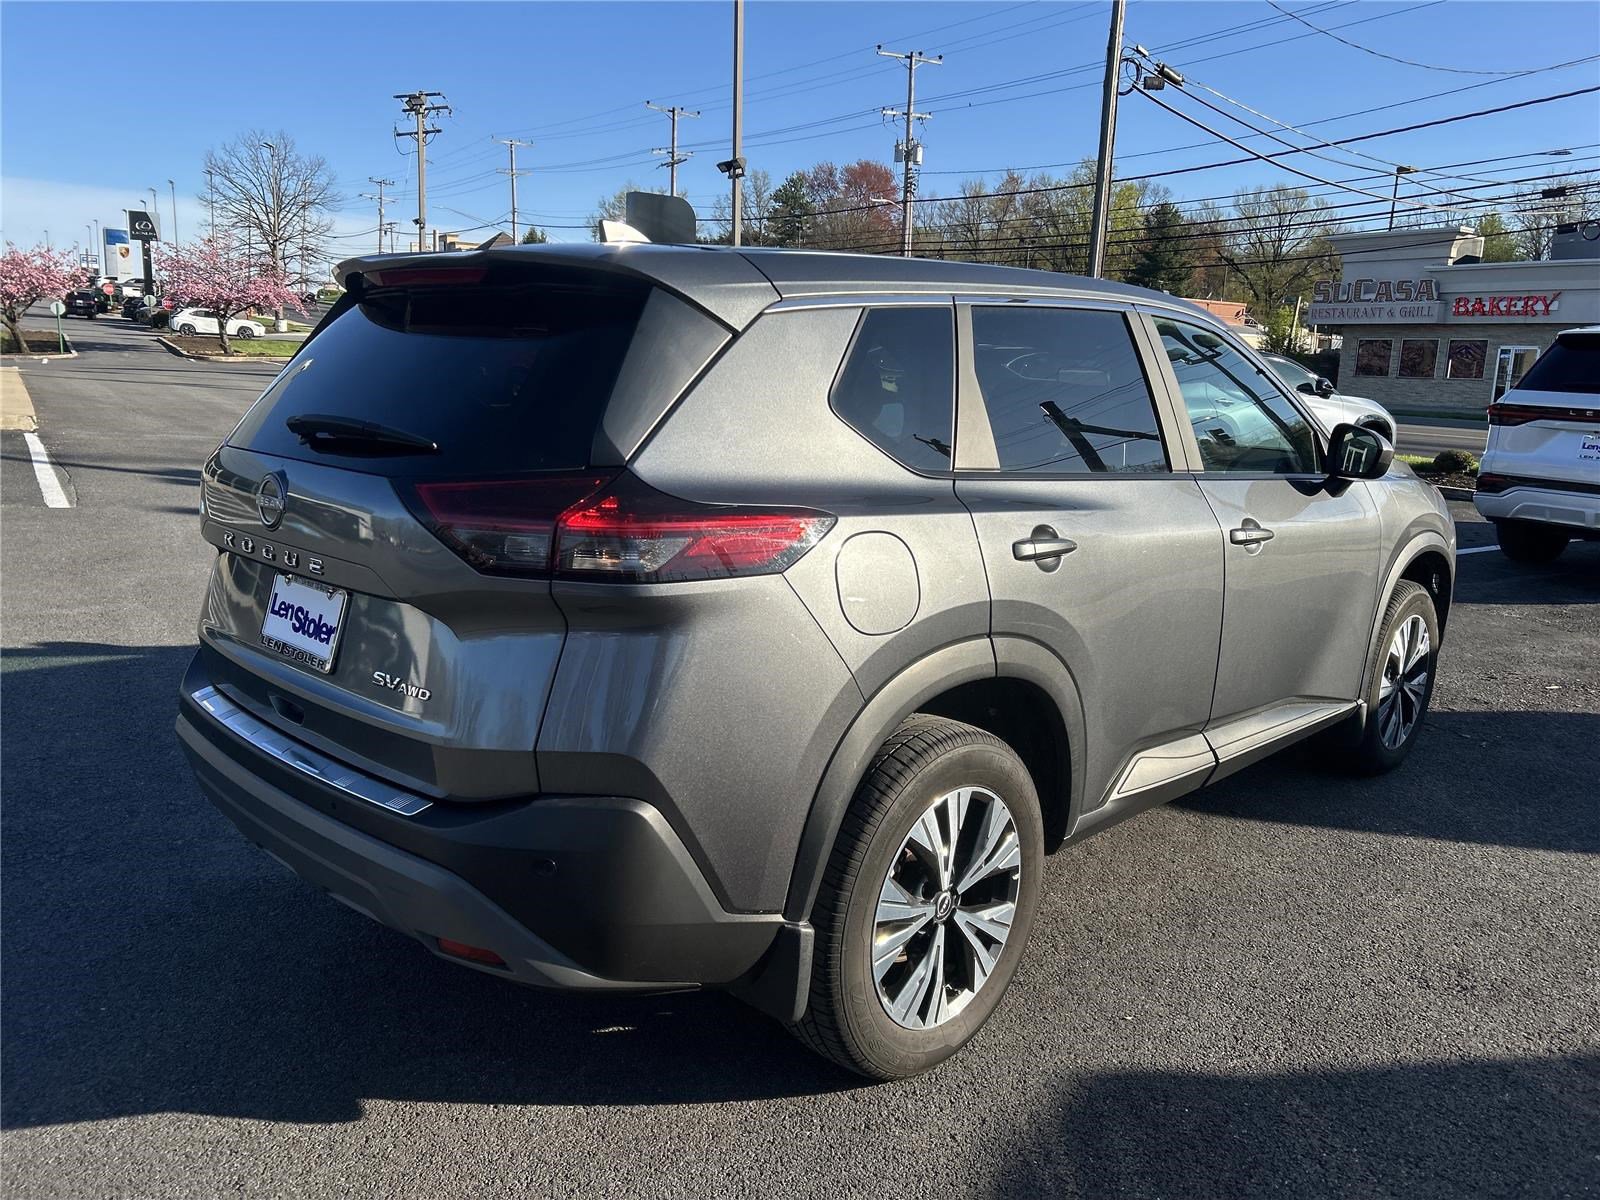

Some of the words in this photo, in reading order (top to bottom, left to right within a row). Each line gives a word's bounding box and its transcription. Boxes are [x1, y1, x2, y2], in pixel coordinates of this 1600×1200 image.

[1311, 306, 1384, 319] RESTAURANT
[1387, 307, 1394, 317] &
[1400, 306, 1433, 317] GRILL
[1453, 292, 1562, 317] BAKERY
[224, 530, 323, 575] ROGUE
[261, 634, 282, 653] LEN
[283, 645, 326, 670] STOLER
[372, 671, 401, 690] SV
[397, 683, 432, 701] AWD
